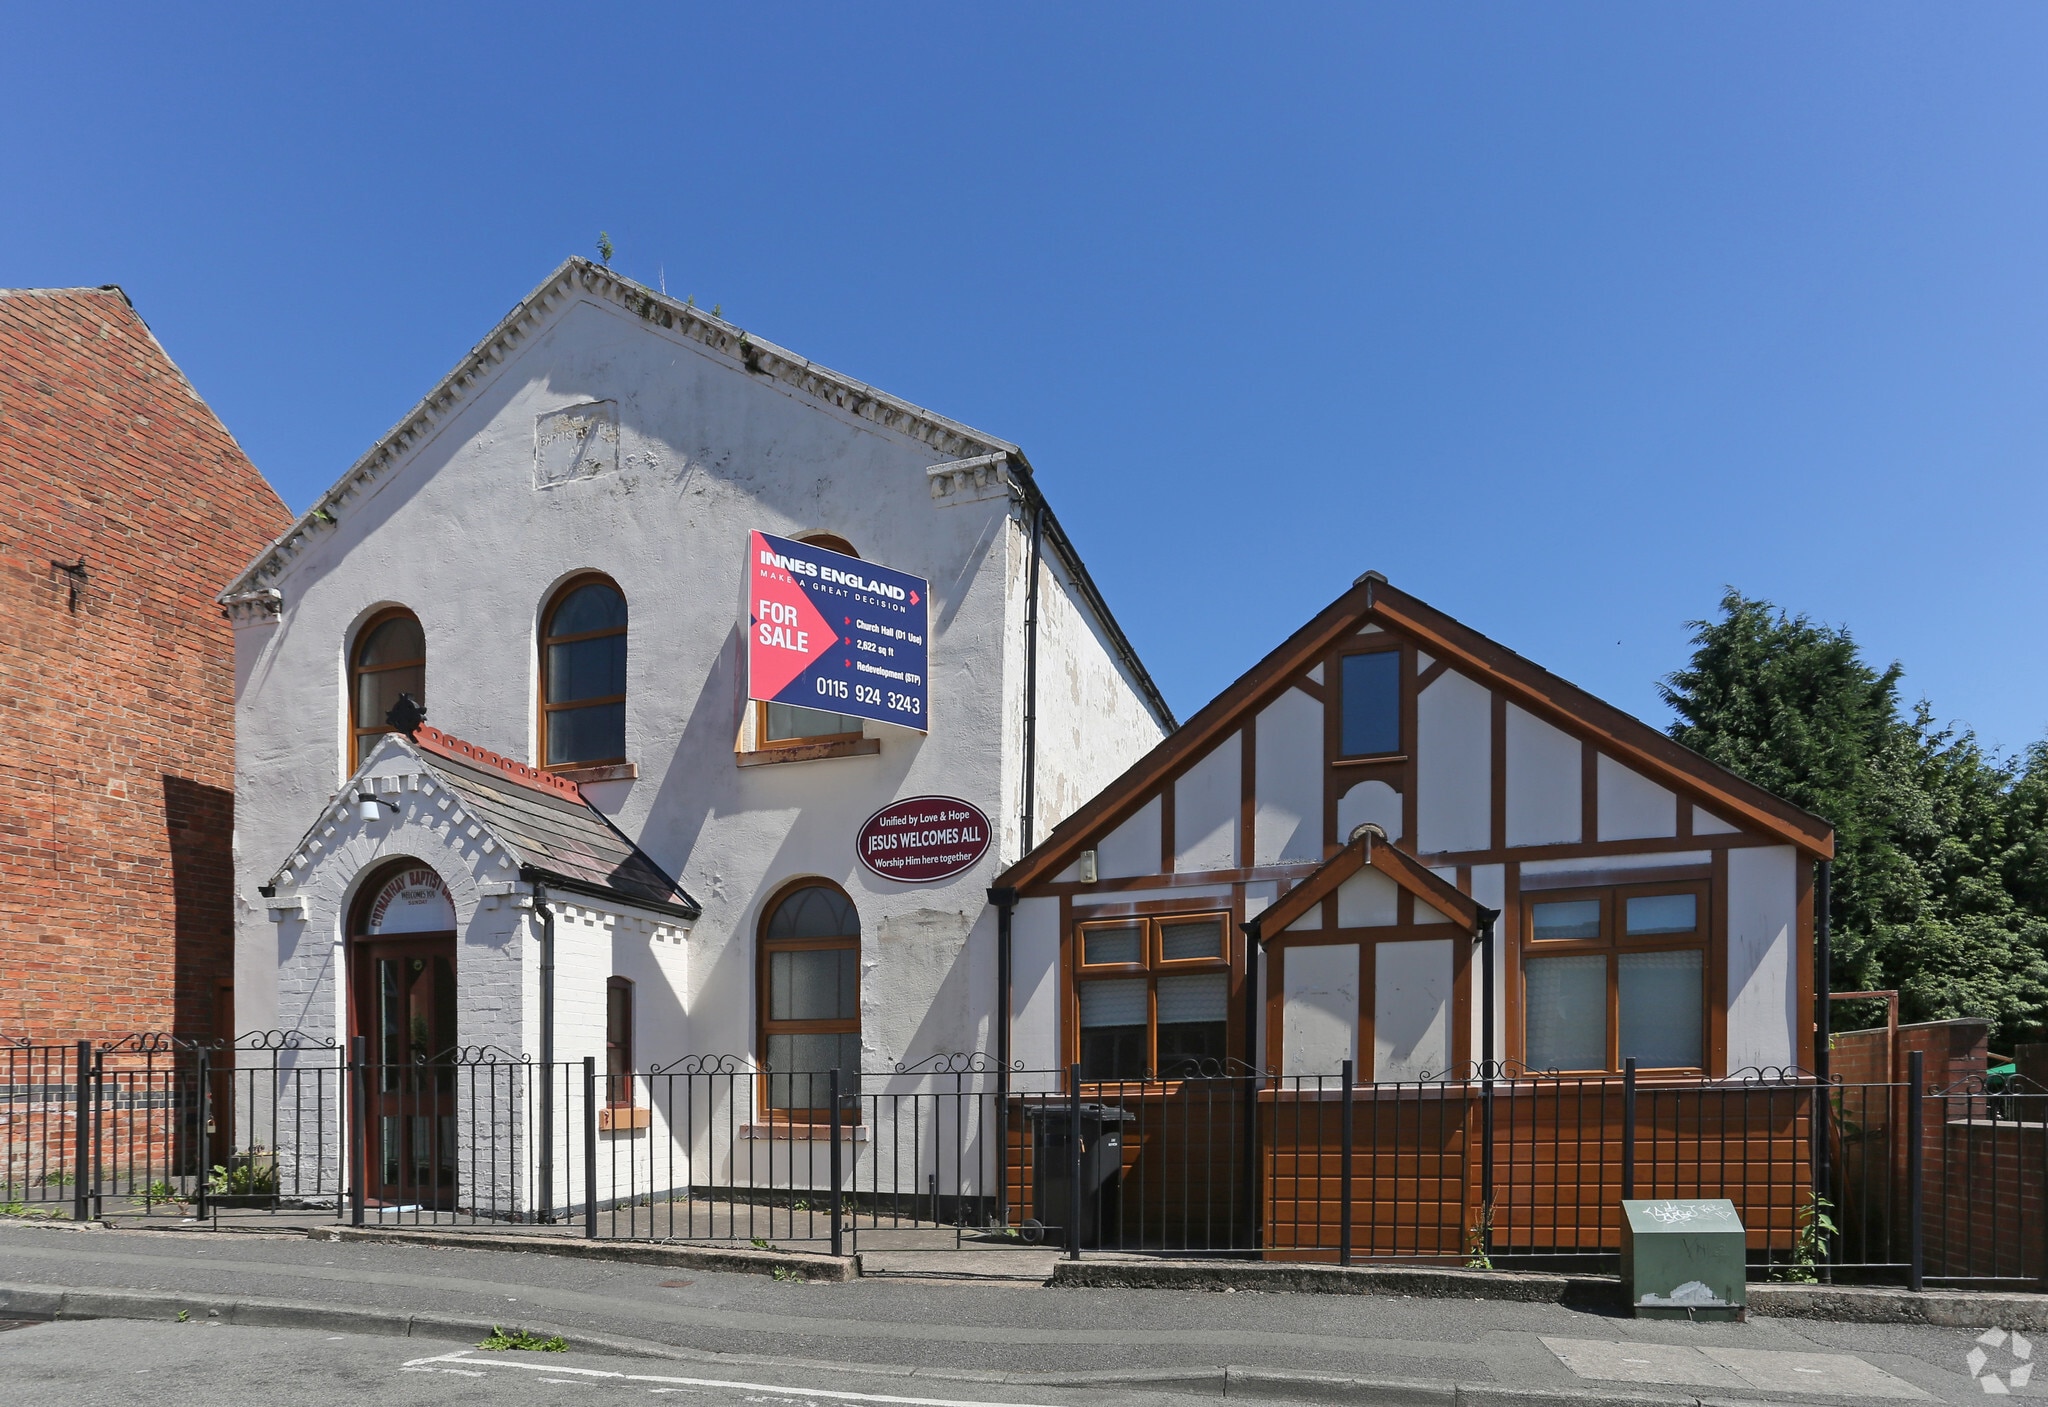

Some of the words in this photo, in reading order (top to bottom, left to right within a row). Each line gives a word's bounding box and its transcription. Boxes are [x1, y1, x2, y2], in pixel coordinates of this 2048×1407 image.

[760, 550, 818, 577] INNES
[820, 566, 906, 601] ENGLAND
[760, 570, 793, 584] MAKE
[799, 579, 806, 587] A
[812, 582, 849, 598] GREAT
[854, 593, 906, 614] DECISION
[759, 600, 798, 627] FOR
[759, 623, 809, 653] SALE
[856, 619, 880, 634] Church
[881, 624, 894, 637] Hall
[895, 629, 907, 641] (D1
[907, 632, 923, 646] Use)
[856, 639, 877, 654] 2,622
[878, 646, 887, 656] sq
[887, 647, 895, 657] ft
[856, 661, 904, 681] Redevelopment
[904, 674, 921, 686] (STP)
[816, 677, 849, 699] 0115
[855, 684, 882, 706] 924
[887, 691, 921, 715] 3243
[879, 814, 907, 827] Unified
[908, 814, 918, 827] by
[919, 813, 938, 824] Love
[939, 811, 947, 821] &
[948, 810, 970, 822] Hope
[867, 833, 898, 855] JESUS
[899, 828, 959, 848] WELCOMES
[961, 826, 981, 843] ALL
[874, 855, 904, 869] Worship
[905, 855, 921, 866] Him
[921, 854, 939, 865] here
[939, 851, 972, 865] together
[371, 875, 407, 927] COTMANHAY
[409, 870, 443, 891] BAPTIST
